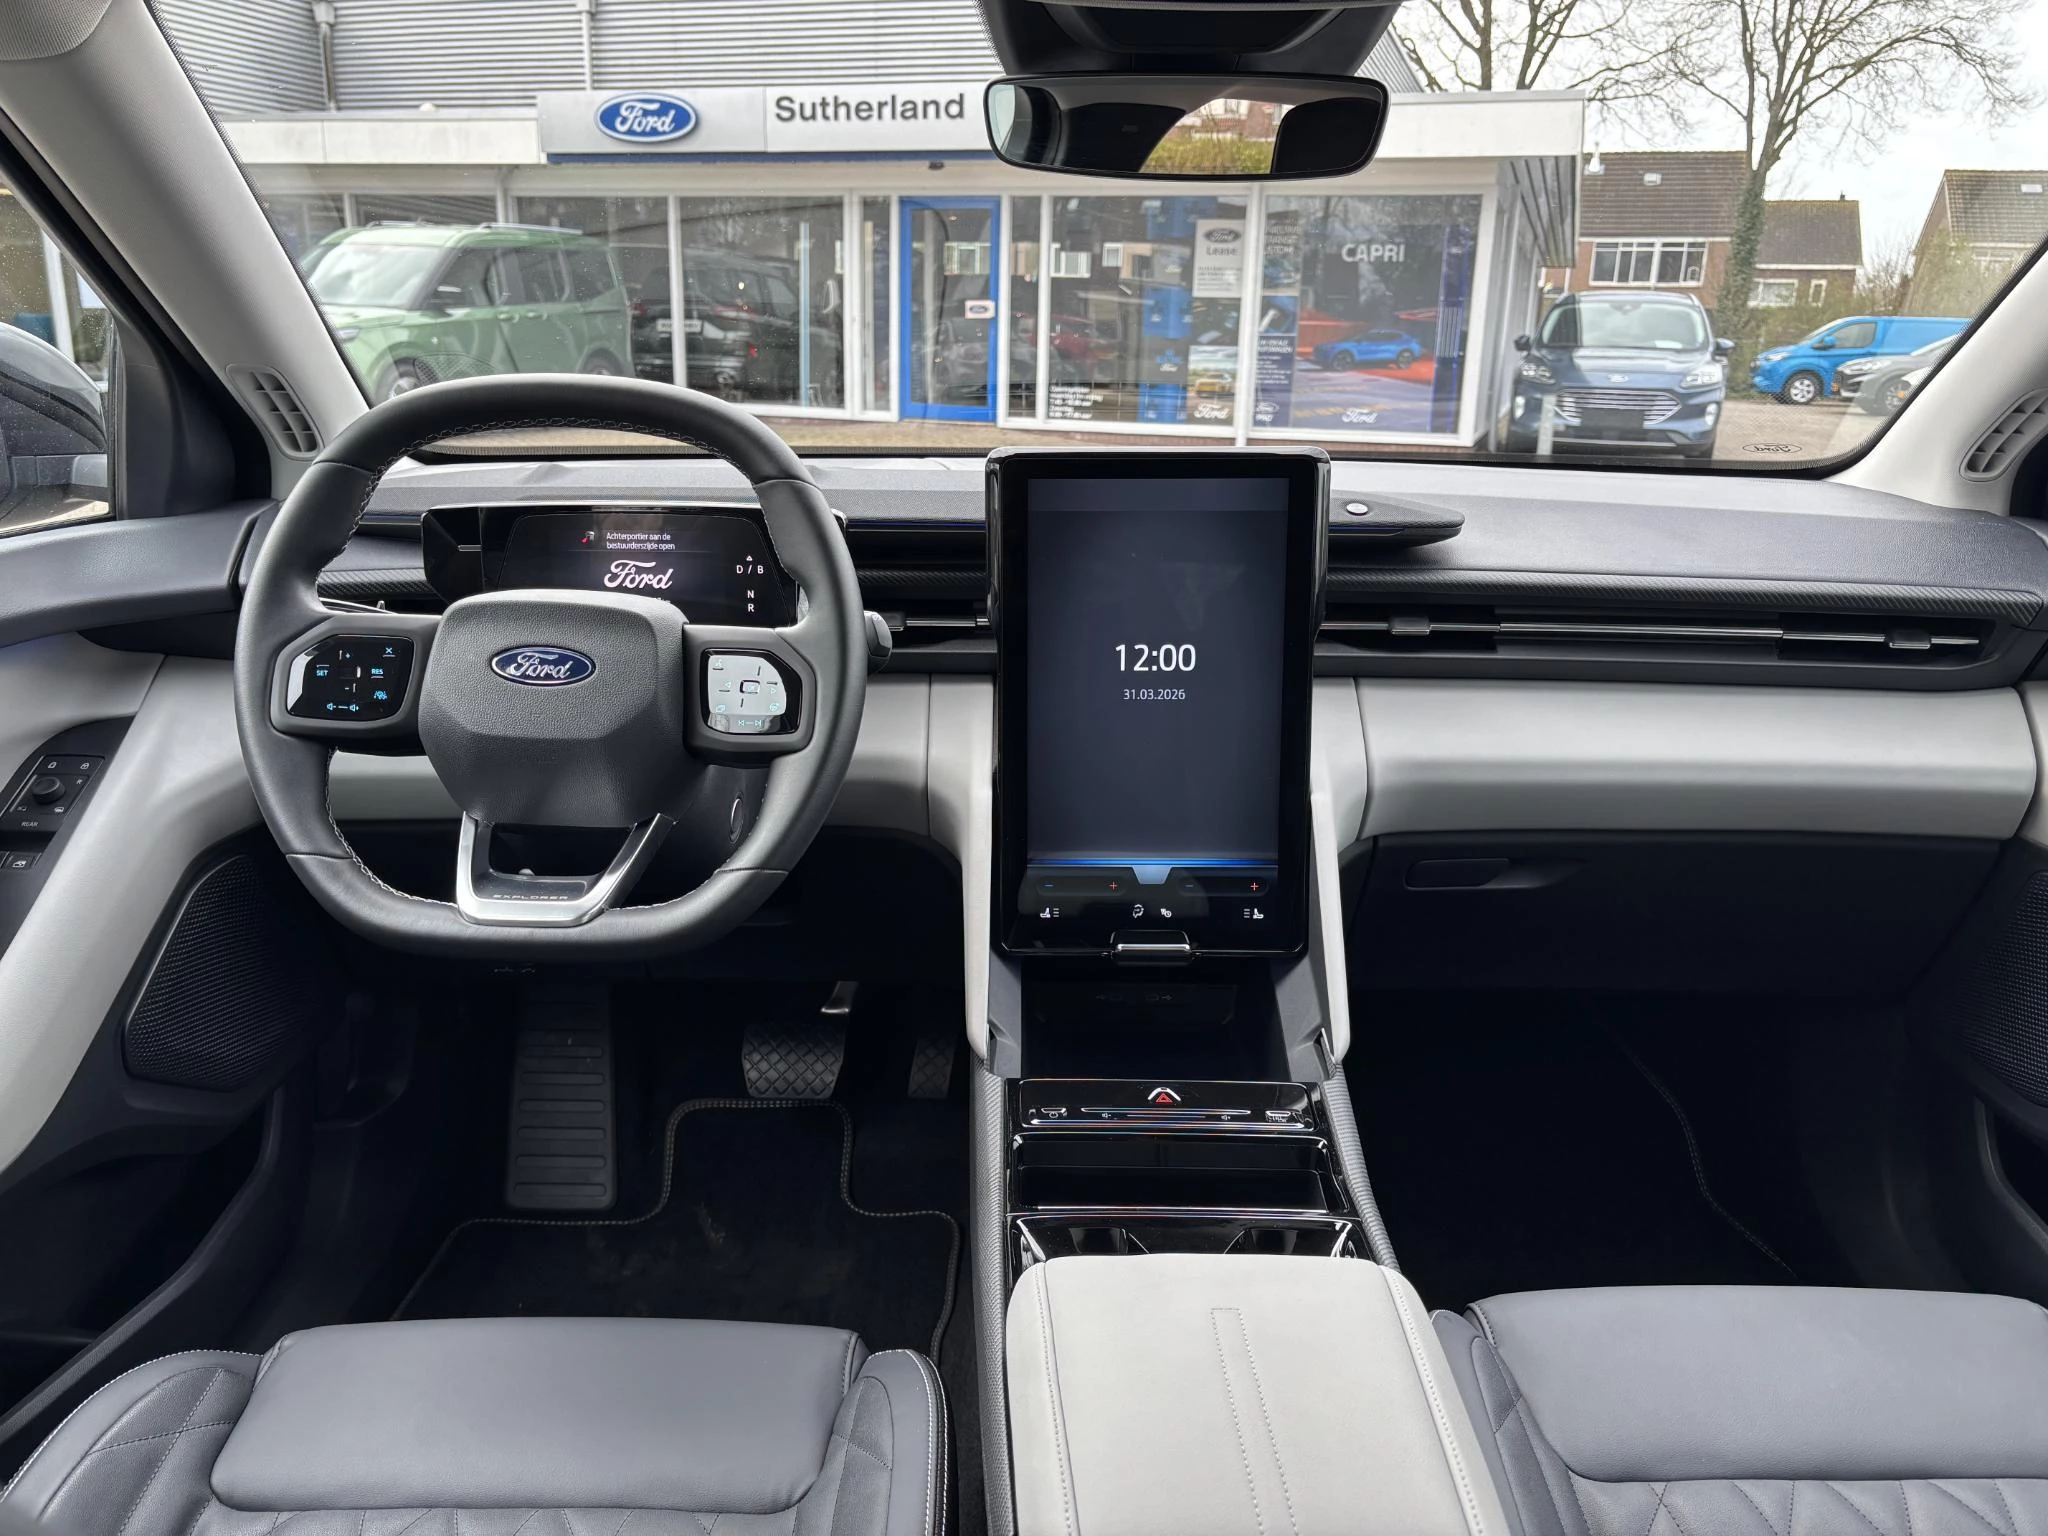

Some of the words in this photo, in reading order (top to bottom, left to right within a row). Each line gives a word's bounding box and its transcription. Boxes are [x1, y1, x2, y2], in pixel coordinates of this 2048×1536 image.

[775, 94, 965, 122] Sutherland
[614, 101, 675, 134] Ford
[1341, 243, 1405, 262] CAPRI
[1194, 402, 1230, 419] Ford
[1342, 408, 1378, 424] Ford
[606, 532, 648, 541] Achterportier
[606, 542, 658, 550] bestuurderszijde
[659, 543, 676, 551] open
[604, 560, 674, 590] Ford
[736, 565, 744, 574] D
[757, 565, 764, 574] B
[747, 590, 755, 599] N
[747, 603, 755, 612] R
[507, 652, 571, 679] Ford
[1115, 644, 1196, 672] 12:00
[1123, 688, 1186, 701] 31.03.2026
